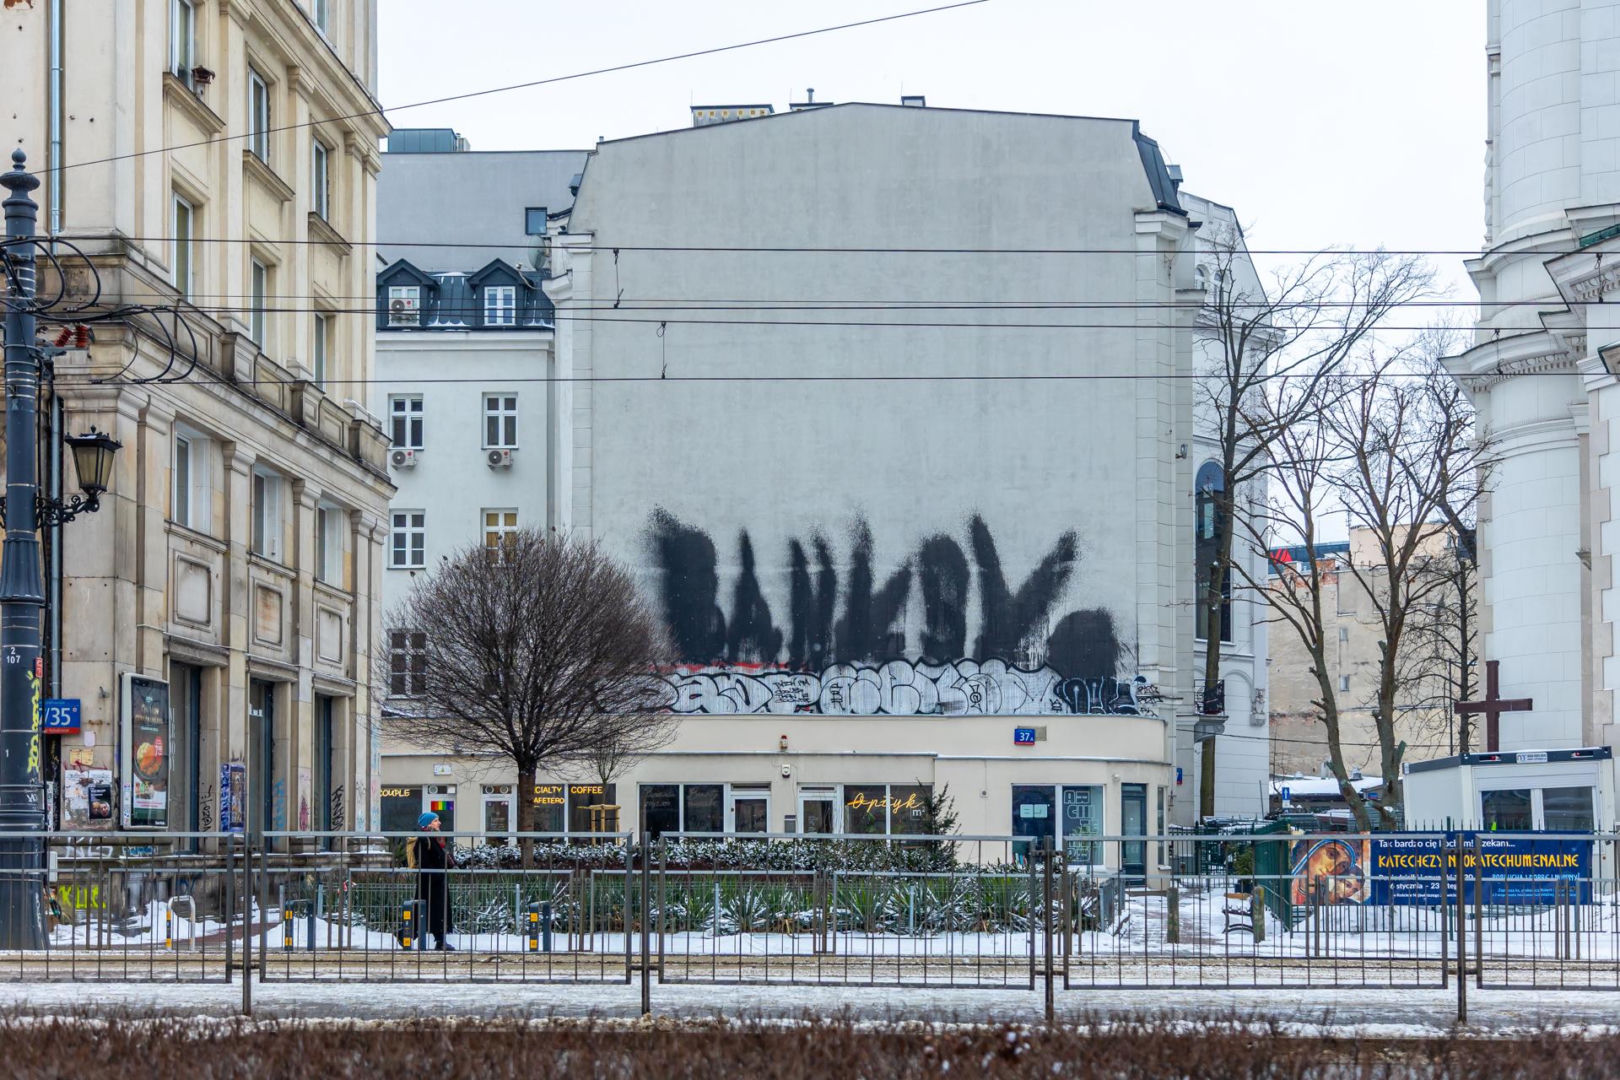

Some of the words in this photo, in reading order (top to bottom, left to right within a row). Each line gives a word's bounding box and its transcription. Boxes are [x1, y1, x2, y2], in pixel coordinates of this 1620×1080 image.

[11, 647, 16, 655] 2
[7, 655, 20, 664] 107
[534, 786, 562, 794] CIALTY
[571, 786, 603, 794] COFFEE
[848, 792, 924, 814] Optyk
[1378, 854, 1442, 868] KATECHEZY
[1430, 882, 1440, 890] 23
